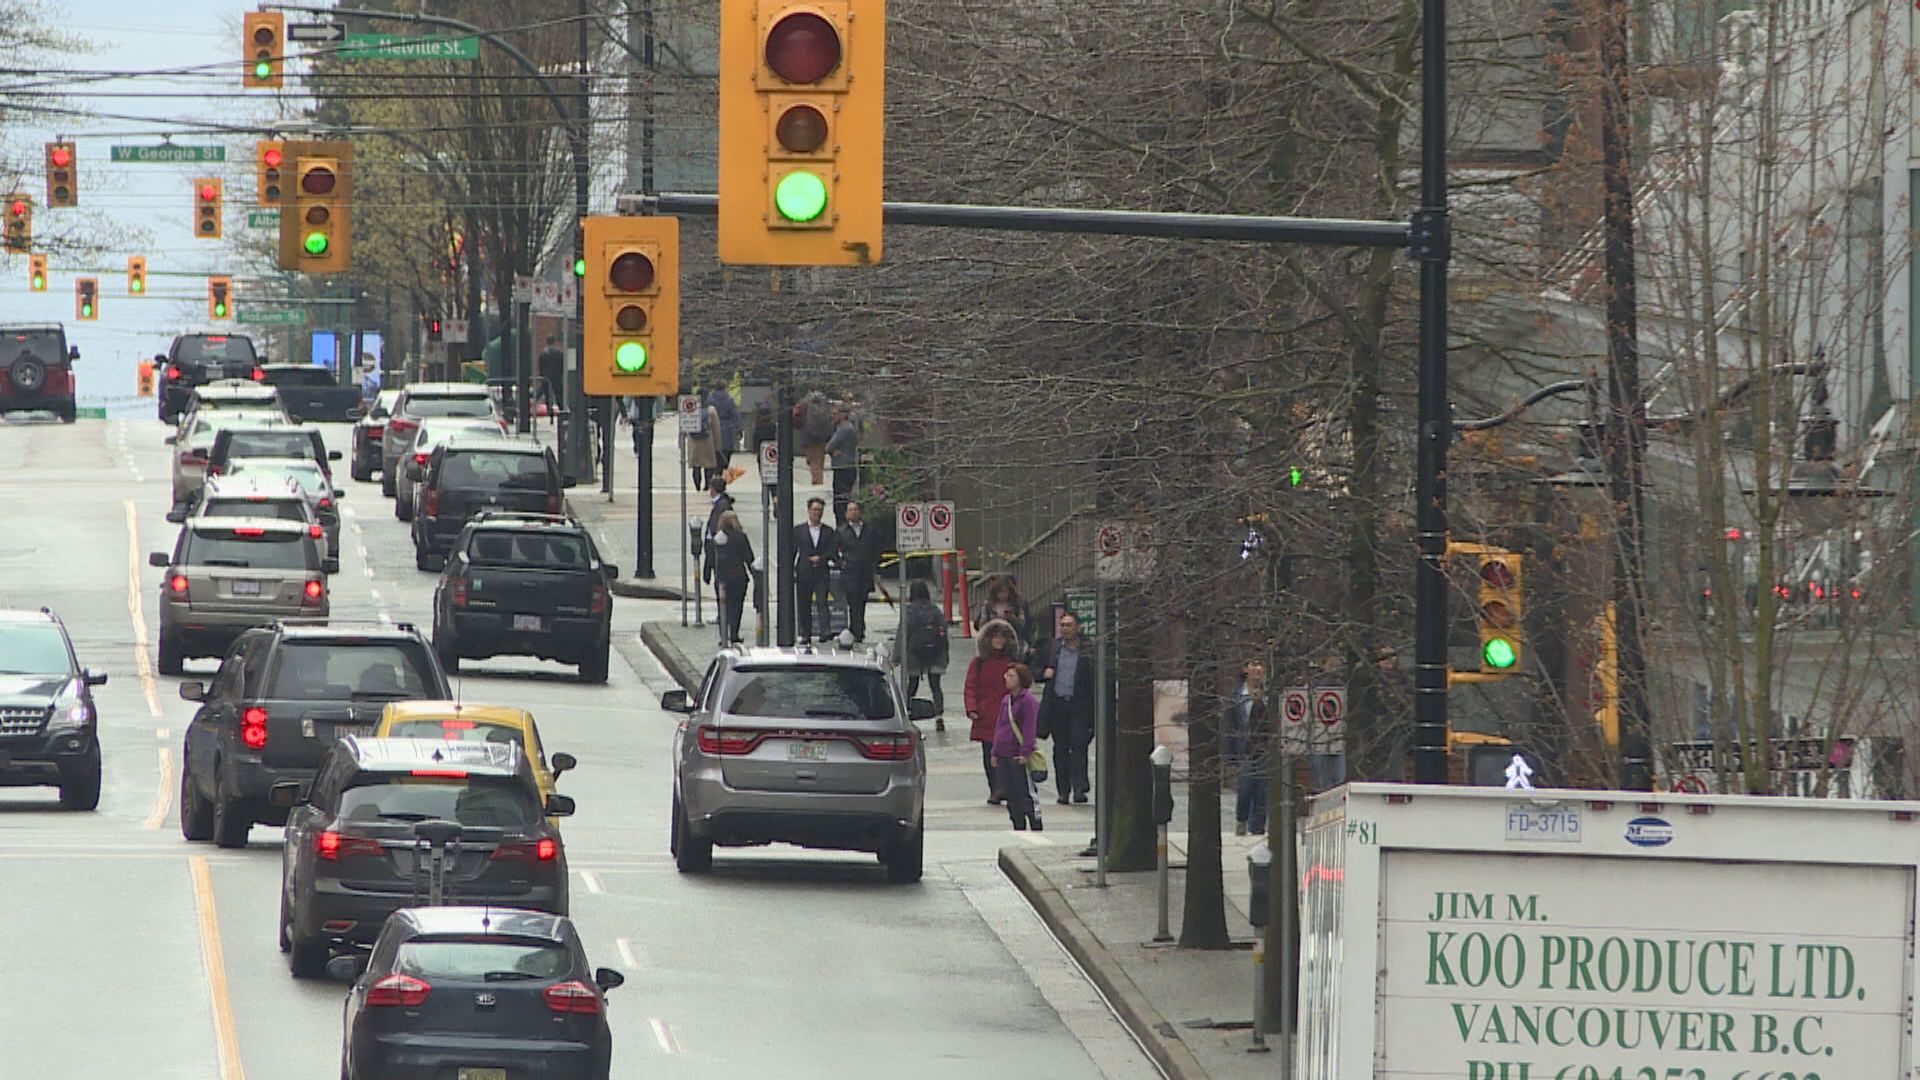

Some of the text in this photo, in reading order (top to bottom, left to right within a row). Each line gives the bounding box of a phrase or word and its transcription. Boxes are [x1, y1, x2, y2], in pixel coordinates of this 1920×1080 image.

[379, 38, 465, 56] Melville St.
[118, 147, 218, 161] W Georgia St
[254, 214, 281, 227] Albe
[1345, 819, 1379, 846] #81
[1428, 891, 1549, 922] JIM M.
[1424, 930, 1866, 1001] KOO PRODUCE LTD.
[1450, 1002, 1834, 1057] VANCOUVER B.C.
